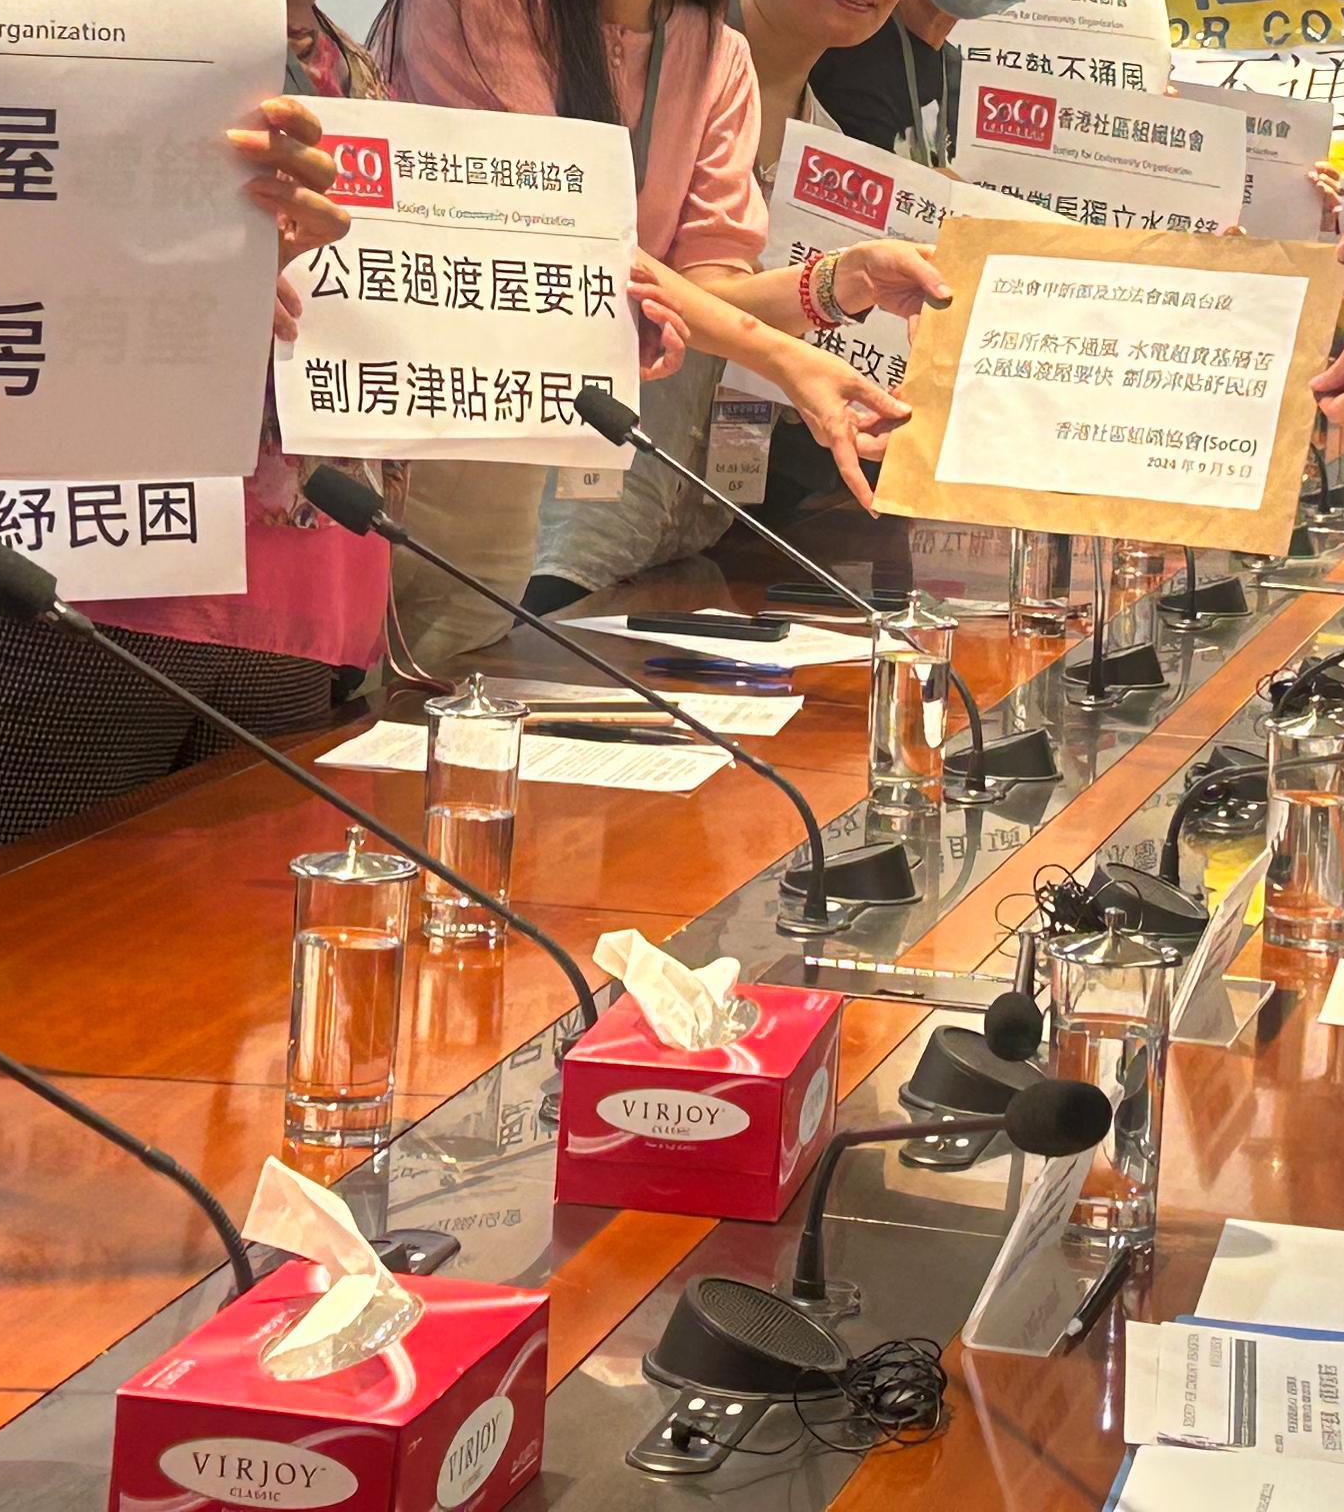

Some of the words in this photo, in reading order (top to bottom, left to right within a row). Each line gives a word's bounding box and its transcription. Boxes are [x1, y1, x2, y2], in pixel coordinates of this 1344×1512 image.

[333, 142, 383, 182] CO
[394, 149, 585, 194] 香港社區組織協會
[308, 244, 617, 319] 公屋過渡屋要快
[622, 1099, 720, 1126] VIRJOY
[191, 1450, 319, 1488] VIRJOY
